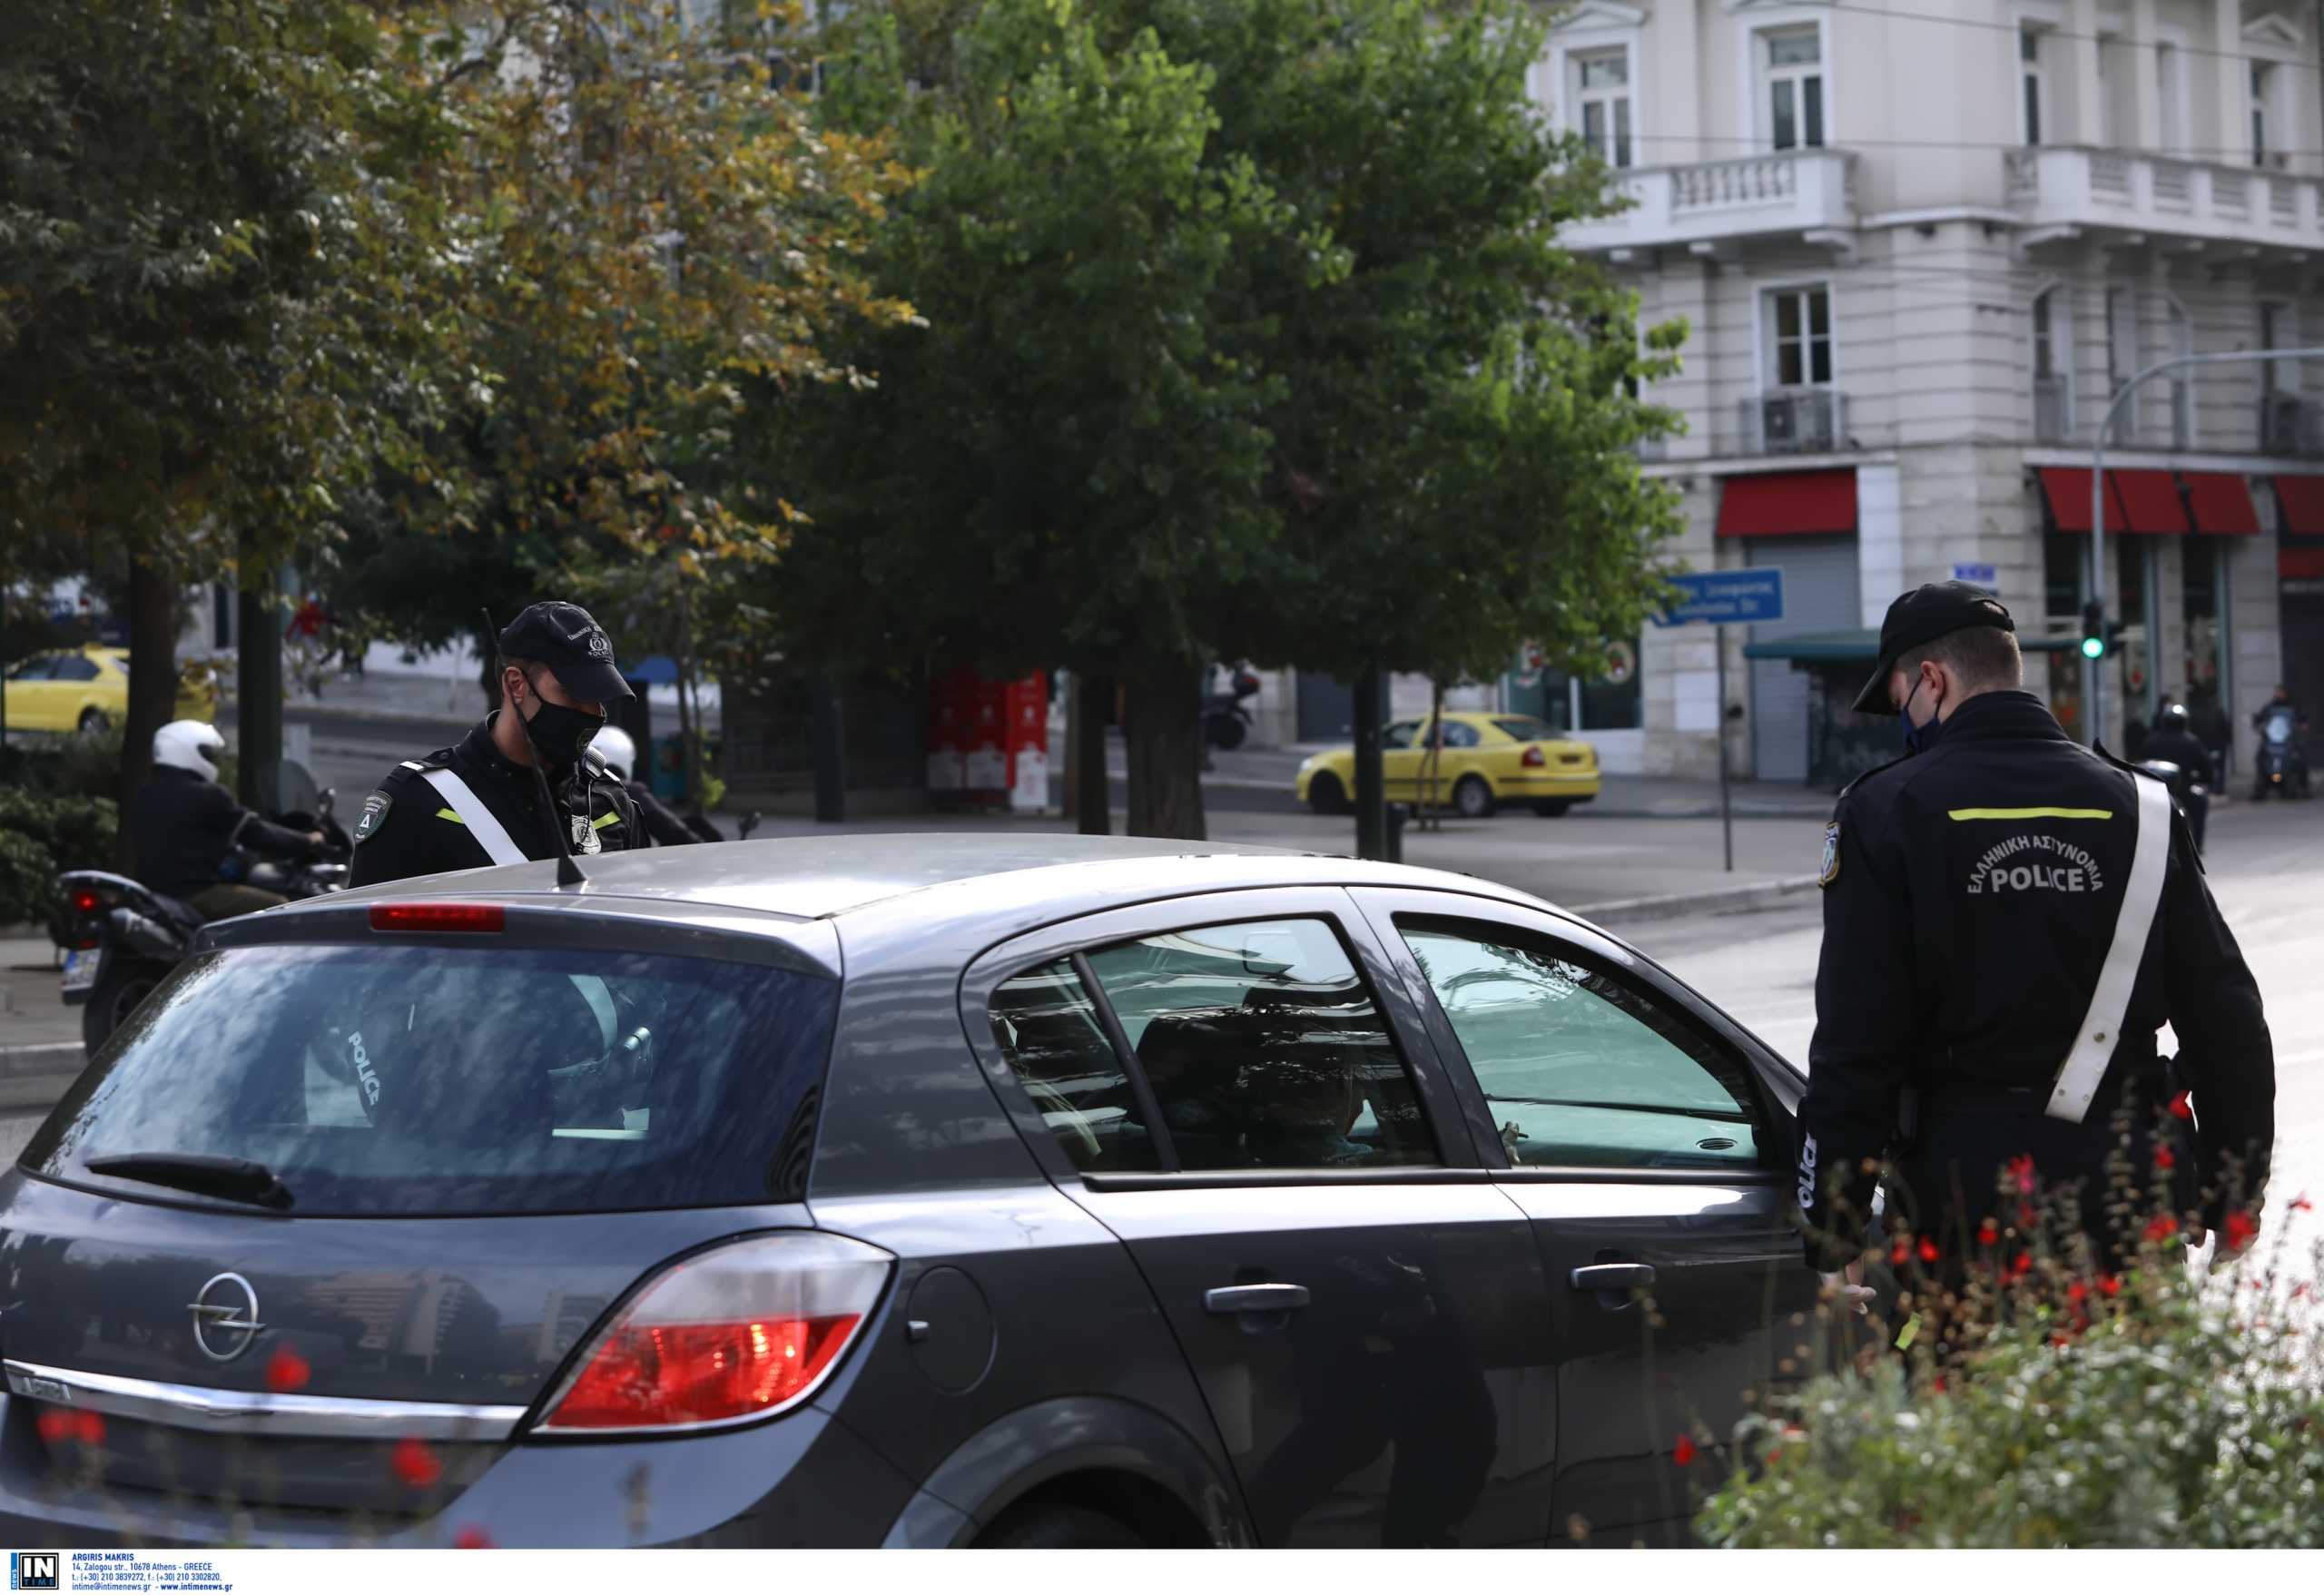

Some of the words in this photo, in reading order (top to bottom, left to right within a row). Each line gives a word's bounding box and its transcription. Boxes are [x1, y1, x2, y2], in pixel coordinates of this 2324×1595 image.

[1967, 835, 2030, 893] ΕΛΛΗΝΙΚΗ
[1990, 863, 2085, 893] POLICE
[348, 1030, 381, 1107] POLICE
